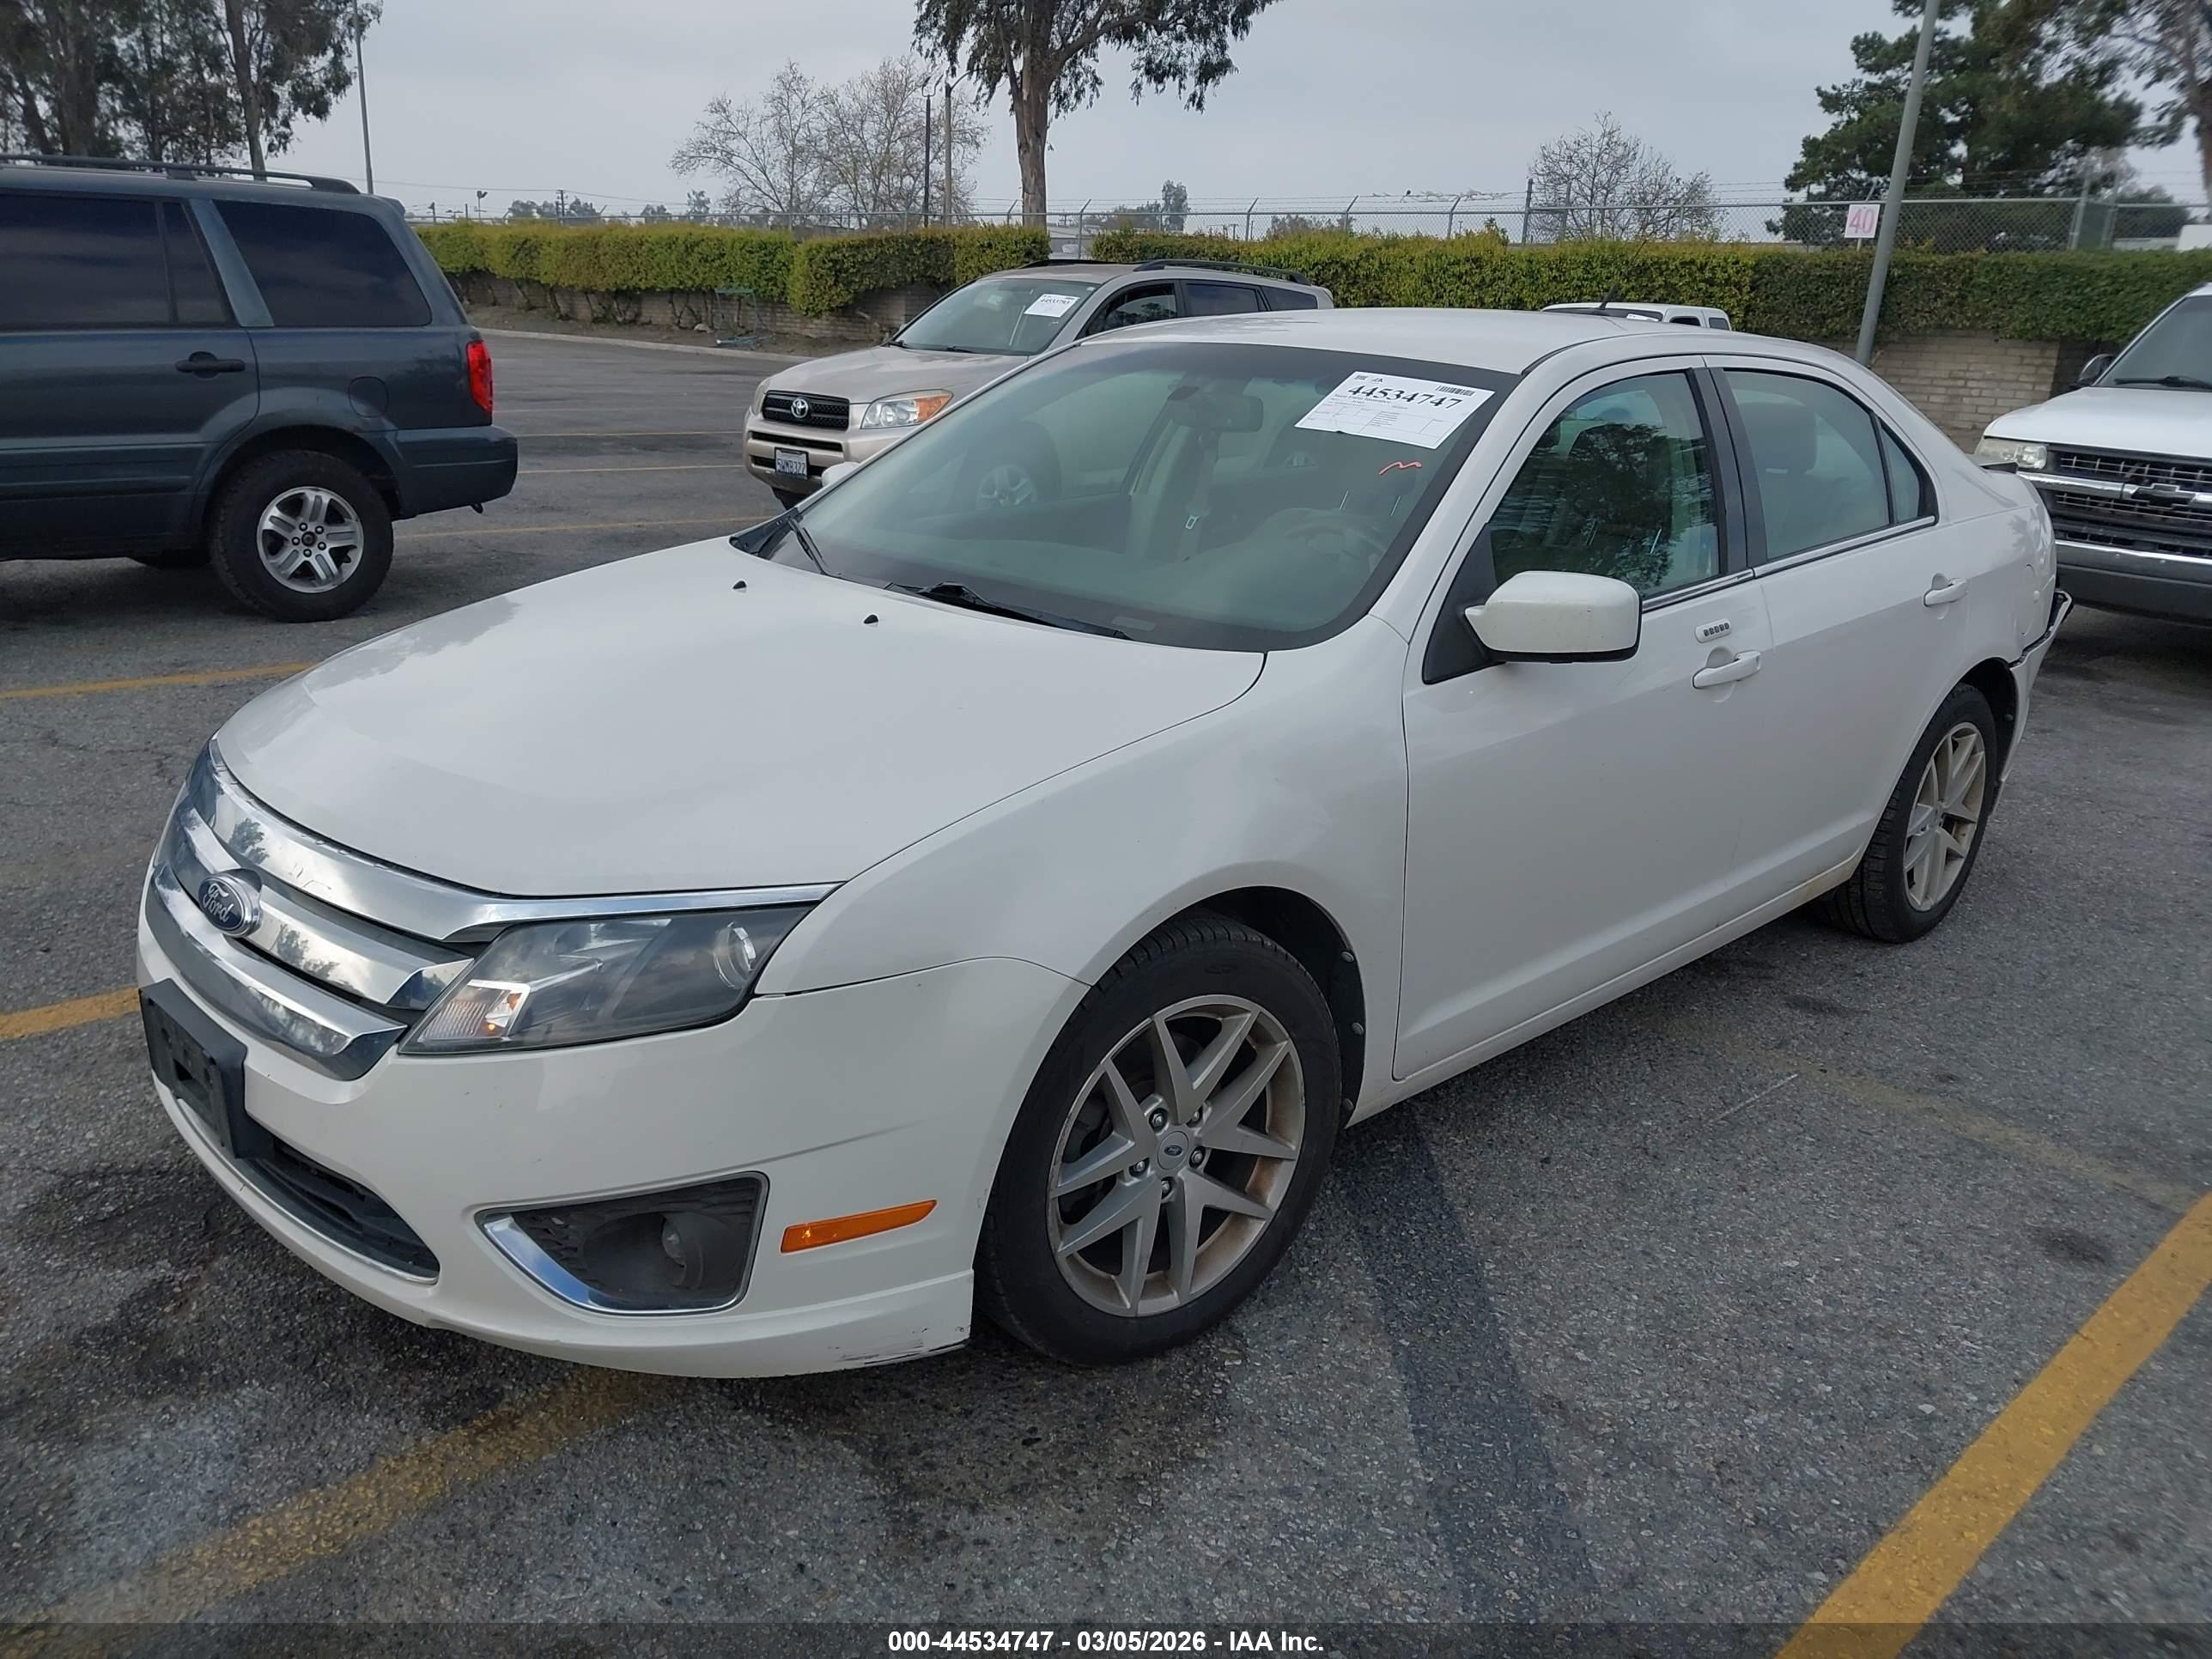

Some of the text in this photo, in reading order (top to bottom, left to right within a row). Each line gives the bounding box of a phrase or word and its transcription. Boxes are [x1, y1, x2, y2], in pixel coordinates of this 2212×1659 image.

[1850, 209, 1875, 234] 40
[1347, 385, 1463, 410] 44534747
[203, 883, 234, 923] Ford
